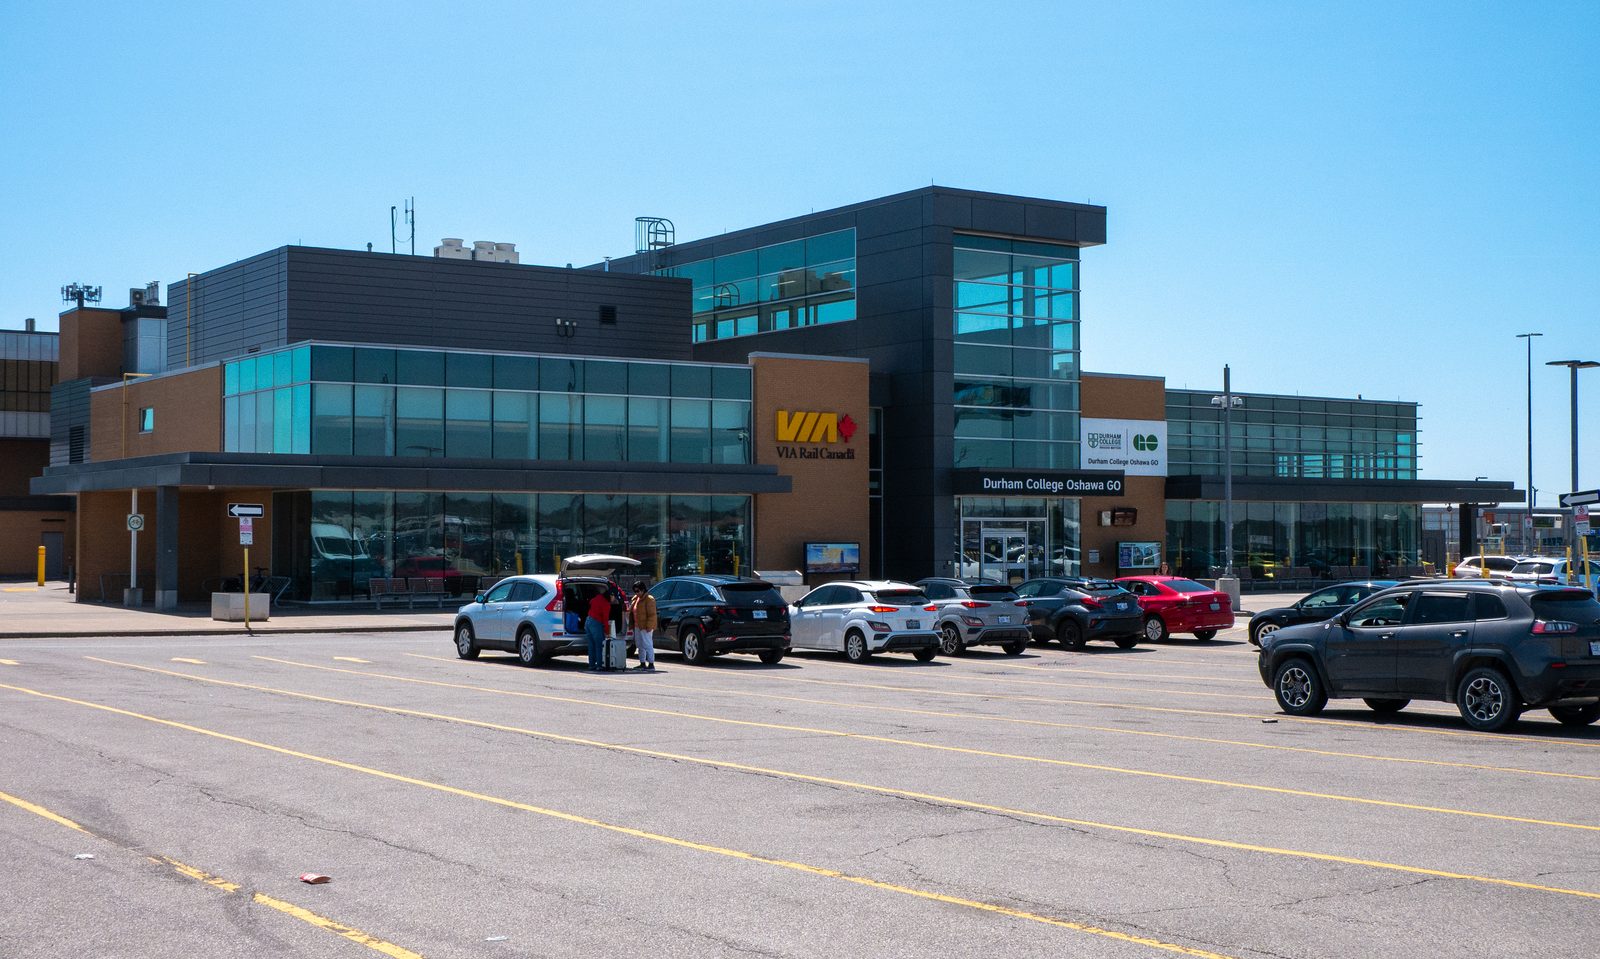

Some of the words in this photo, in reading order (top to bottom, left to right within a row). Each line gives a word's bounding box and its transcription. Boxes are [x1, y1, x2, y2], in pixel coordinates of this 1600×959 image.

[777, 410, 838, 443] VIA
[1133, 434, 1158, 451] GO
[776, 446, 797, 458] VIA
[799, 447, 818, 459] Rail
[819, 448, 855, 459] Canada
[1109, 458, 1129, 466] College
[983, 478, 1023, 489] Durham
[1026, 479, 1063, 492] College
[1066, 479, 1104, 490] Oshawa
[1106, 480, 1121, 491] GO
